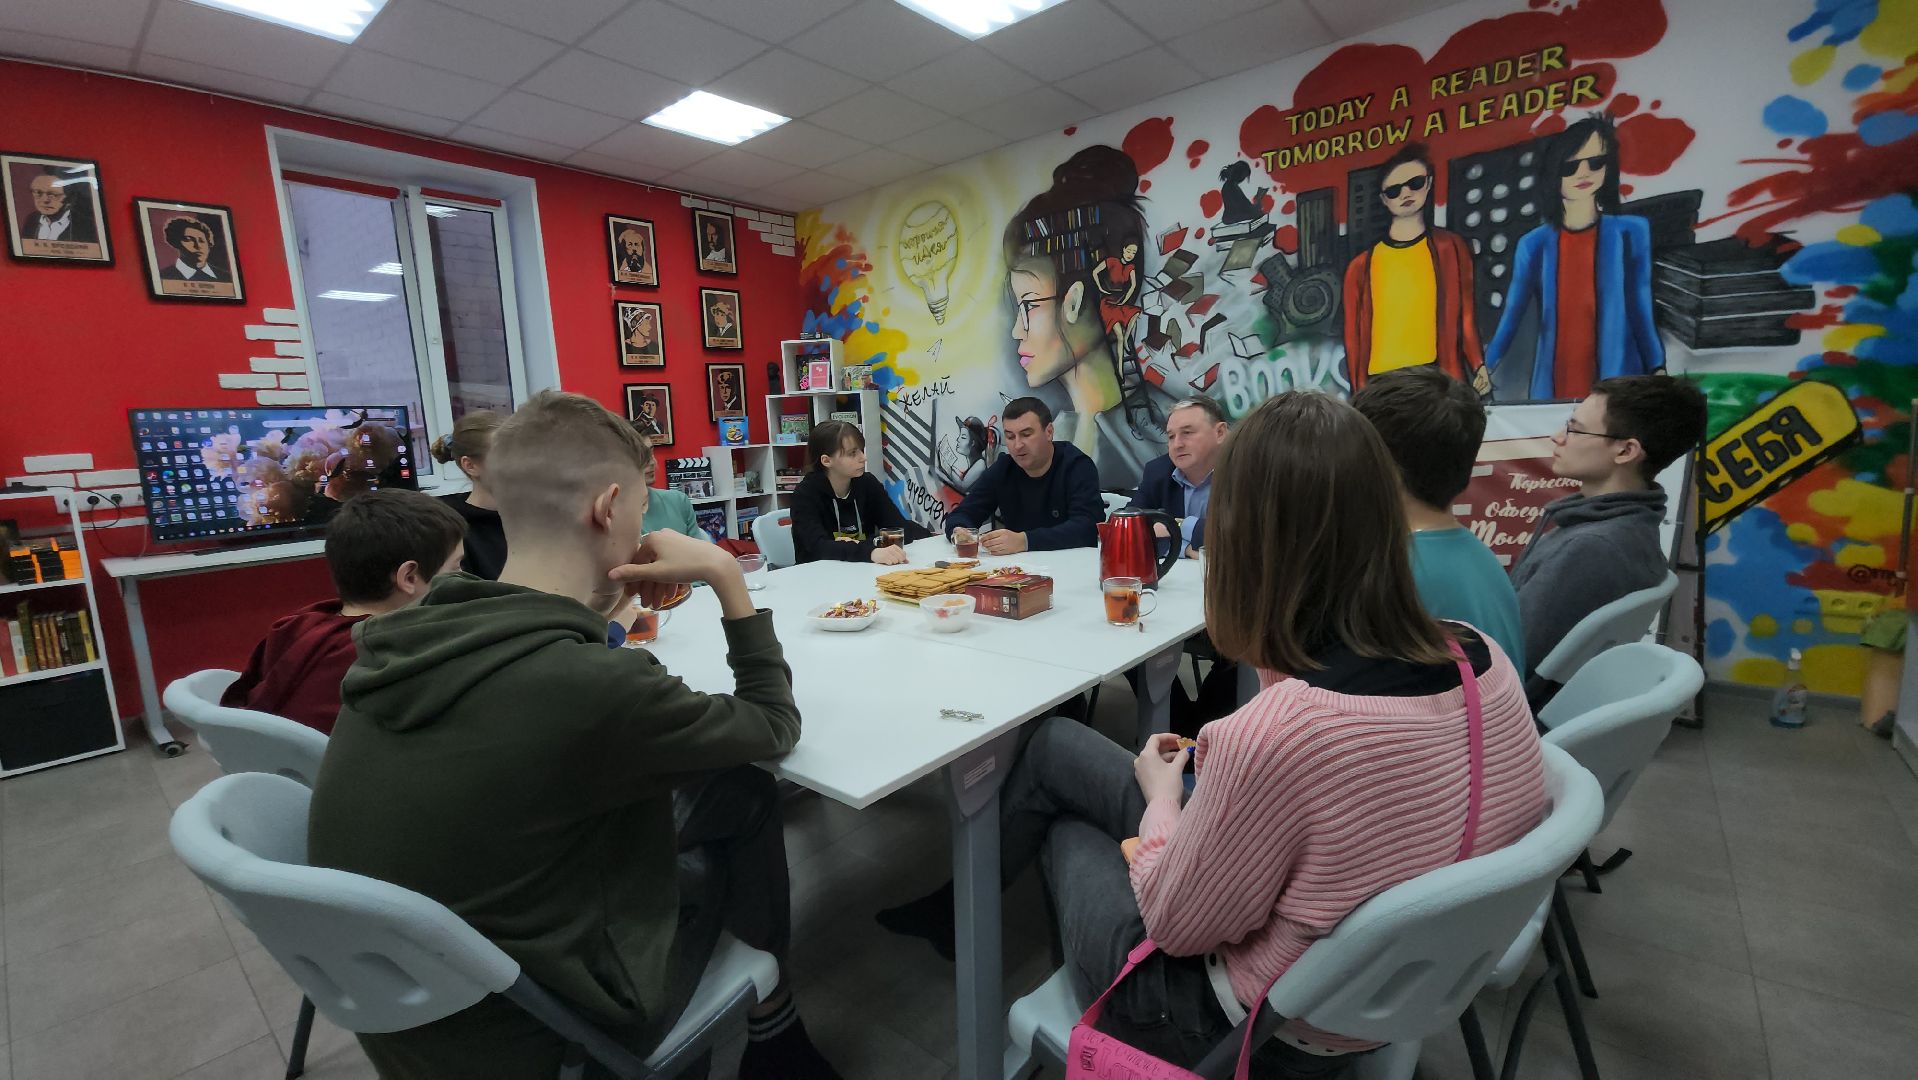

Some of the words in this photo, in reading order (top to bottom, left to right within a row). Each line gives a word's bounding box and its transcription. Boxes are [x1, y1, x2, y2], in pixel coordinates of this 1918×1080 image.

[1261, 118, 1412, 174] TOMORROW
[1423, 111, 1446, 138] A
[1458, 74, 1603, 131] LEADER
[1285, 94, 1375, 137] TODAY
[1389, 85, 1411, 112] A
[1430, 45, 1567, 101] READER
[899, 376, 955, 411] ЖЕЛАЙ
[1695, 405, 1823, 503] СЕБЯ
